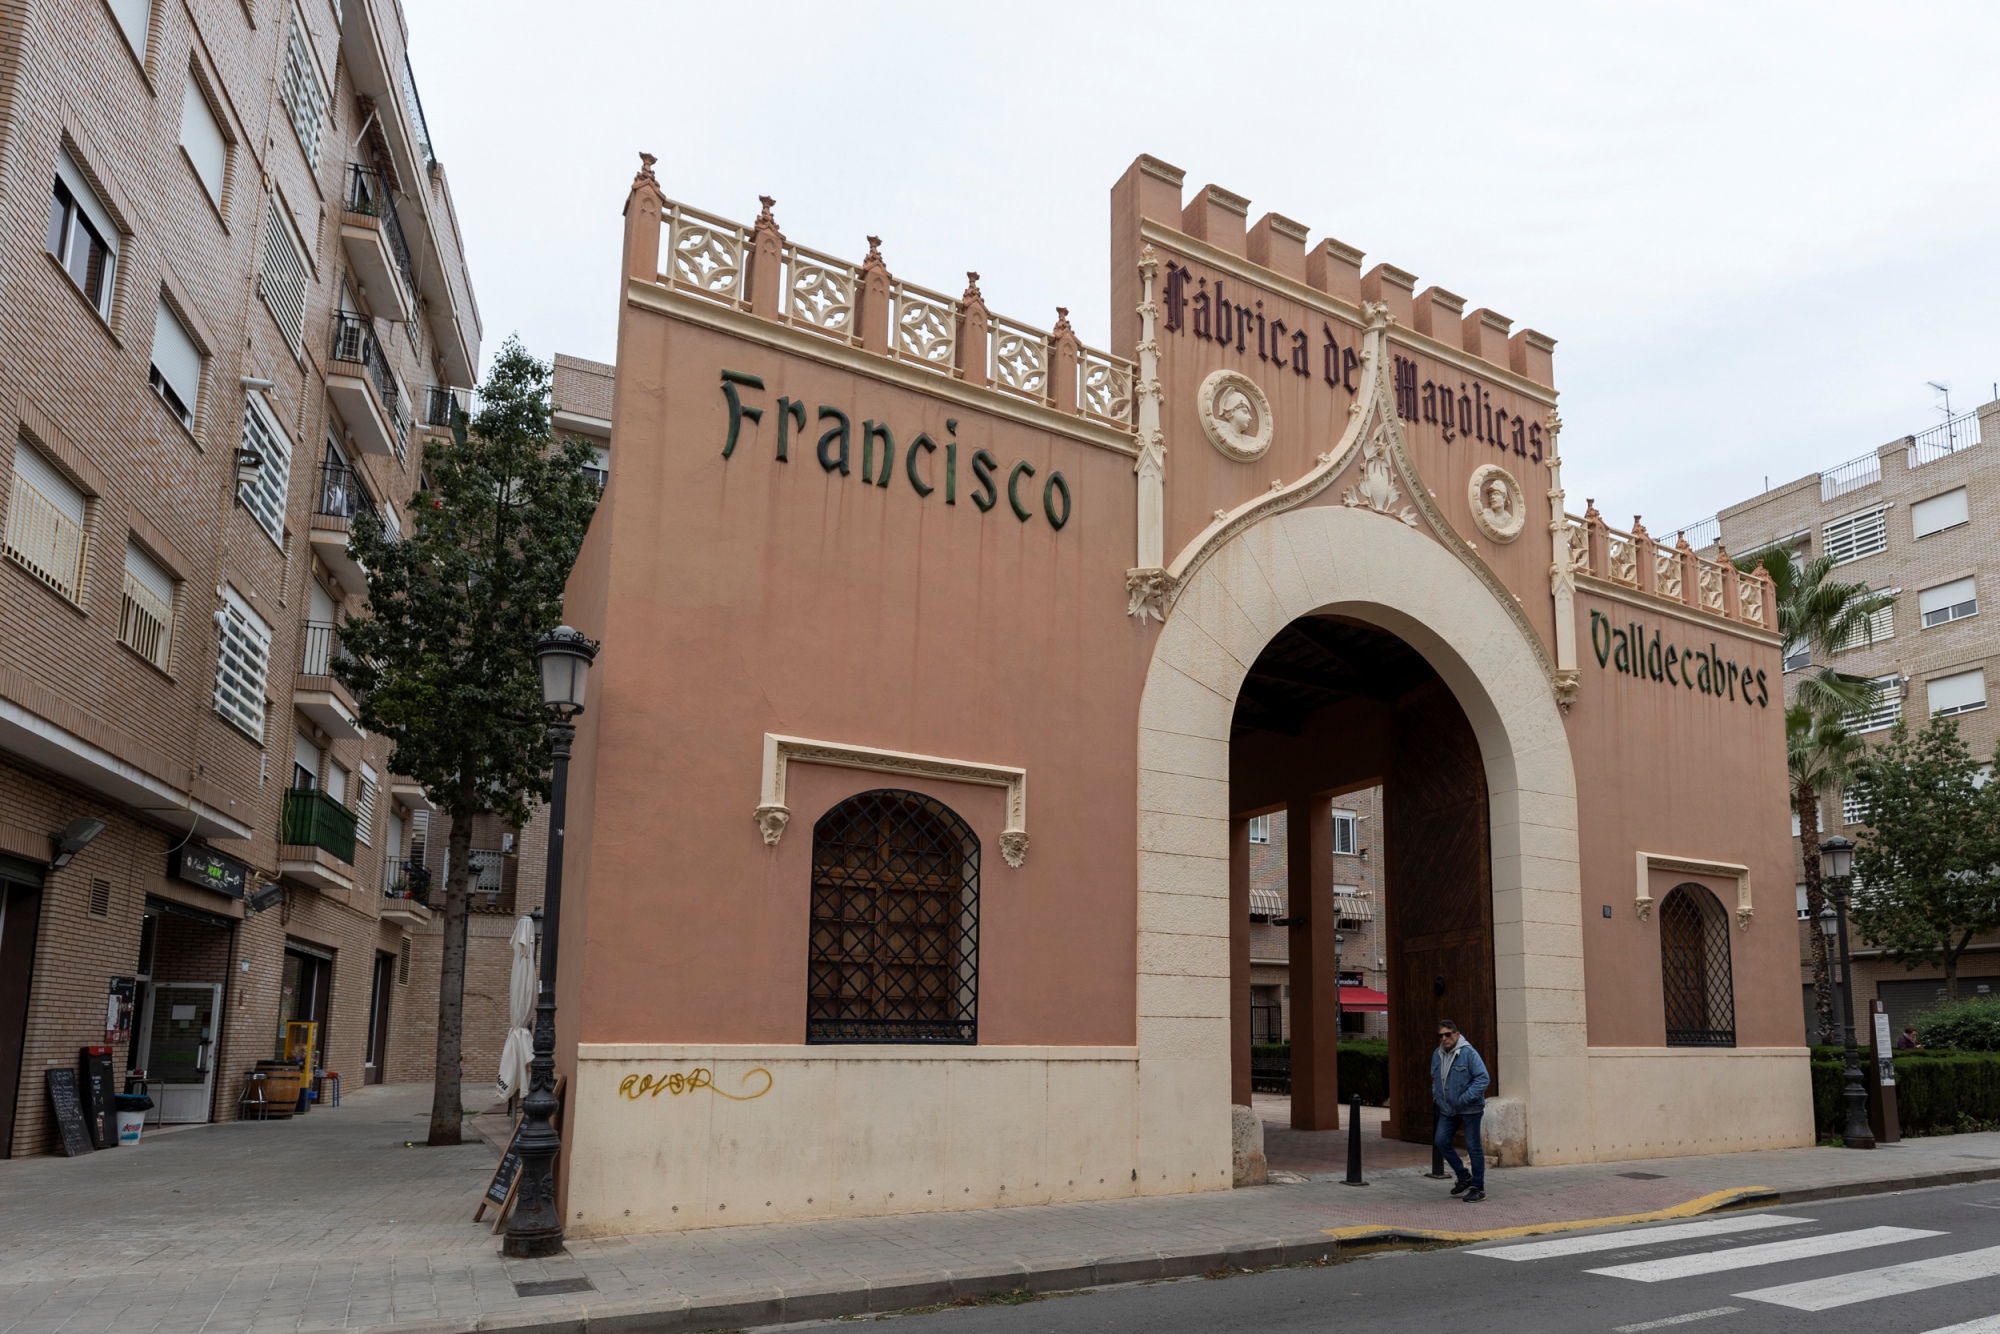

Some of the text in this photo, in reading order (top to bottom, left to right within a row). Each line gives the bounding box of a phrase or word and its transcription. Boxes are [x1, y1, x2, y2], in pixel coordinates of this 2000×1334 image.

[1323, 322, 1359, 394] de
[721, 369, 1071, 531] Francisco
[1590, 609, 1769, 708] Valldecabres
